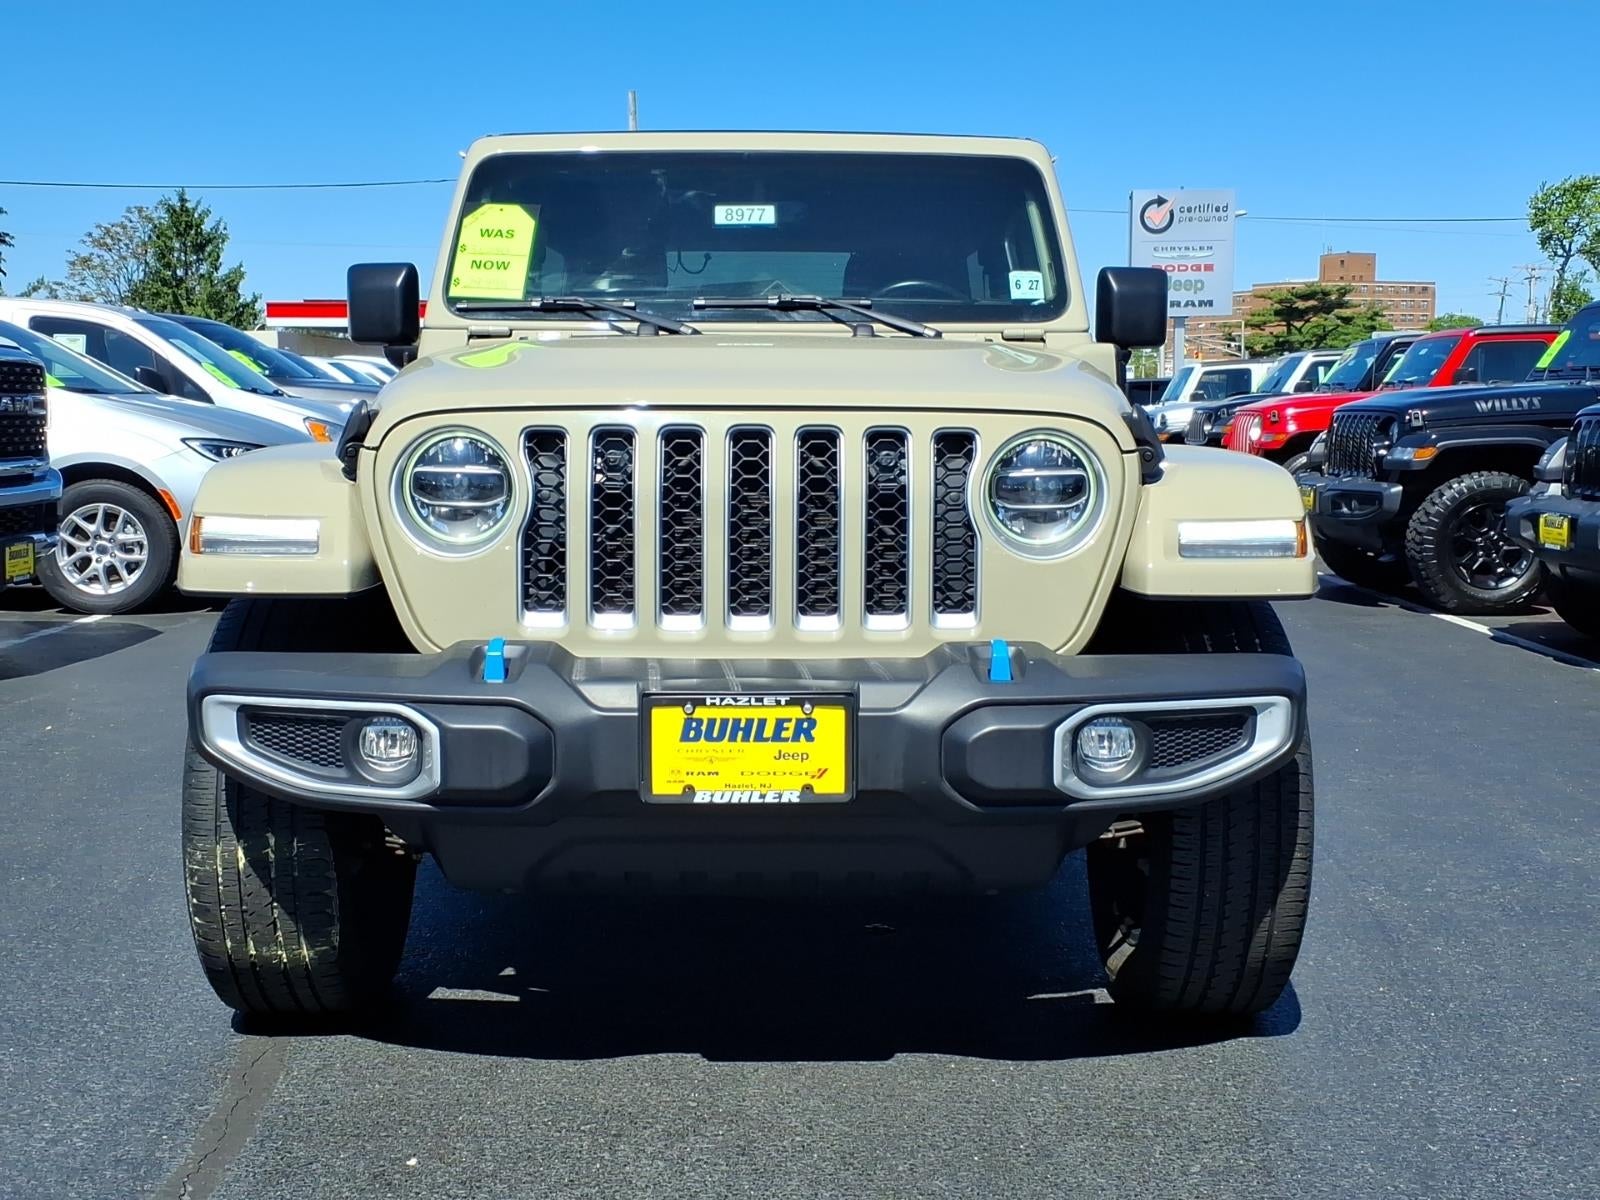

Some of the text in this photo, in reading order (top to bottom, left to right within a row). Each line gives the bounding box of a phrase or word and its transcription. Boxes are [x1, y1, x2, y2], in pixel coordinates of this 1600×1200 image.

[1179, 203, 1228, 213] certified
[725, 207, 765, 222] 8977
[1178, 215, 1228, 224] pre-owned
[480, 228, 515, 239] WAS
[460, 244, 467, 253] $
[470, 260, 511, 271] NOW
[453, 277, 460, 287] $
[1015, 279, 1040, 290] 6 27
[1170, 300, 1213, 308] RAM
[1474, 396, 1542, 413] WILLYS
[705, 697, 790, 706] HAZLET
[679, 717, 817, 742] BUHLER
[773, 749, 810, 763] Jeep
[693, 790, 801, 803] BUHLER
